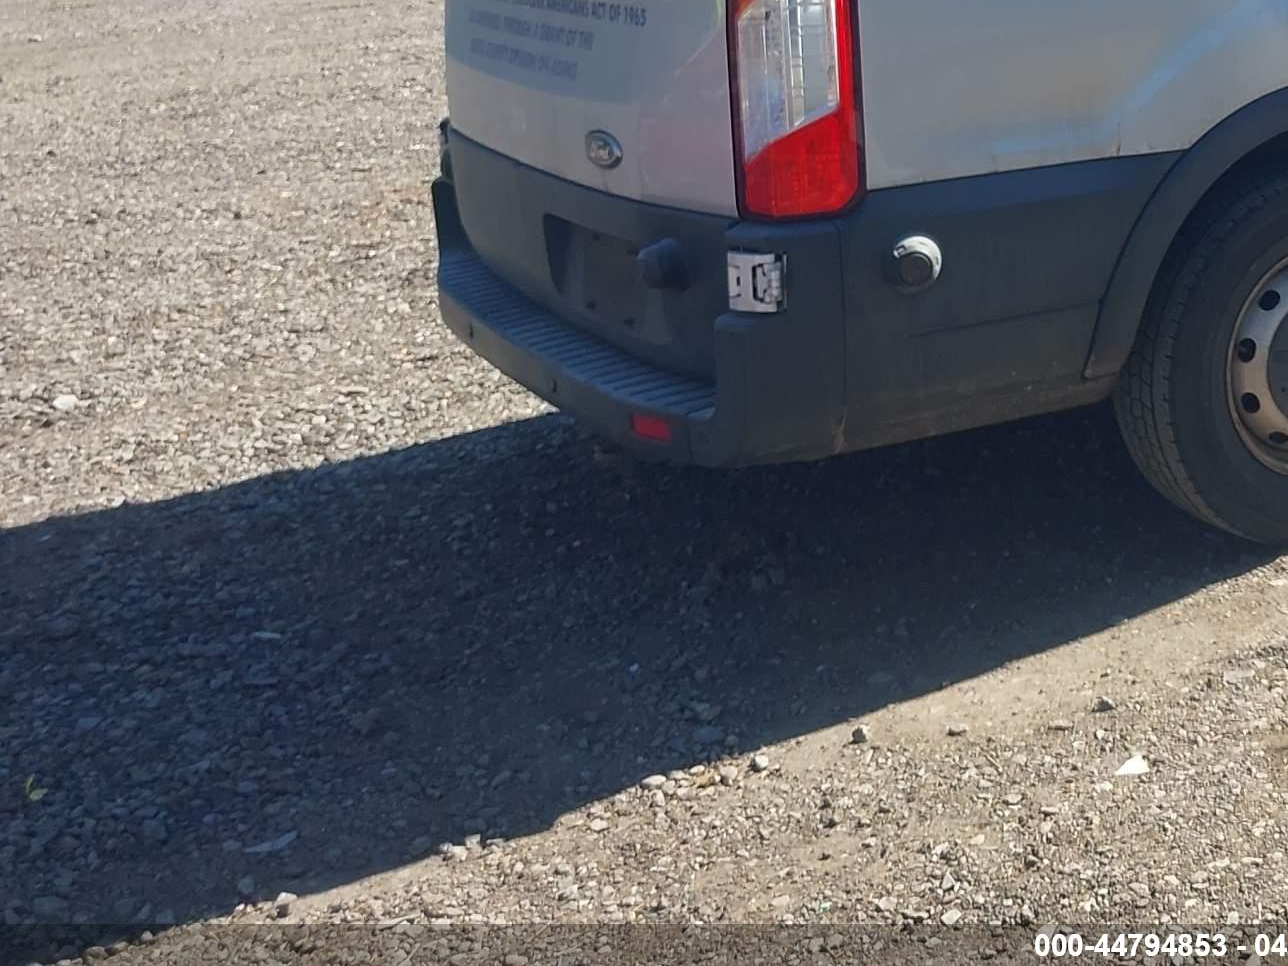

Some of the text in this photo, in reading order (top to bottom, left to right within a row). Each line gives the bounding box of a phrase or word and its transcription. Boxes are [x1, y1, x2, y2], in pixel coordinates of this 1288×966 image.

[591, 1, 607, 20] ACT
[609, 3, 622, 24] OF
[624, 5, 648, 27] 1965
